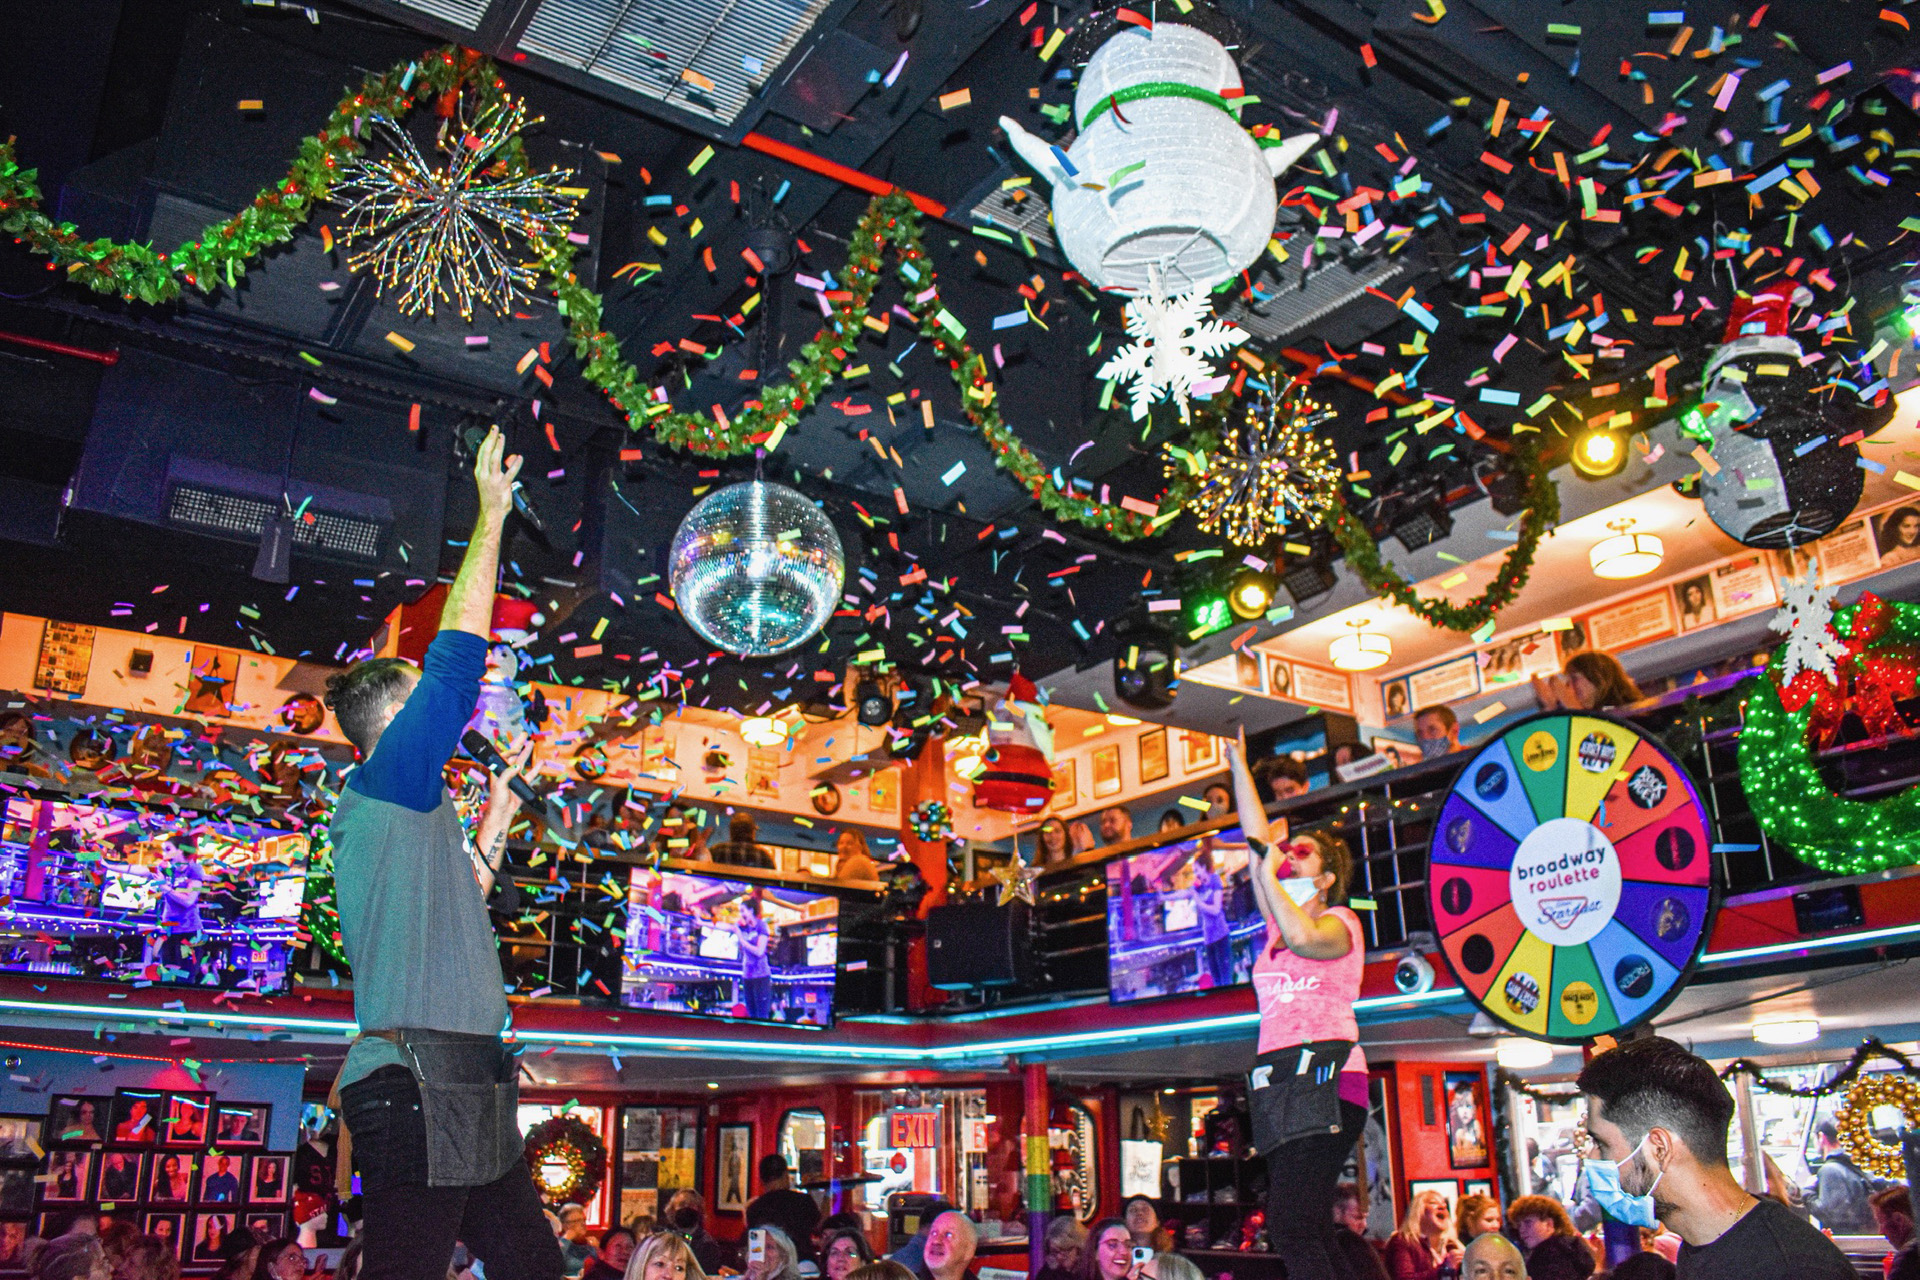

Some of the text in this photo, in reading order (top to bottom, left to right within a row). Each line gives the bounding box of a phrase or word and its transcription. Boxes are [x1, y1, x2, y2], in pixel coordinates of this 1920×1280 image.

[1517, 847, 1605, 880] broadway
[1529, 867, 1599, 894] roulette
[1537, 899, 1603, 925] Stardust
[891, 1112, 938, 1148] EXIT
